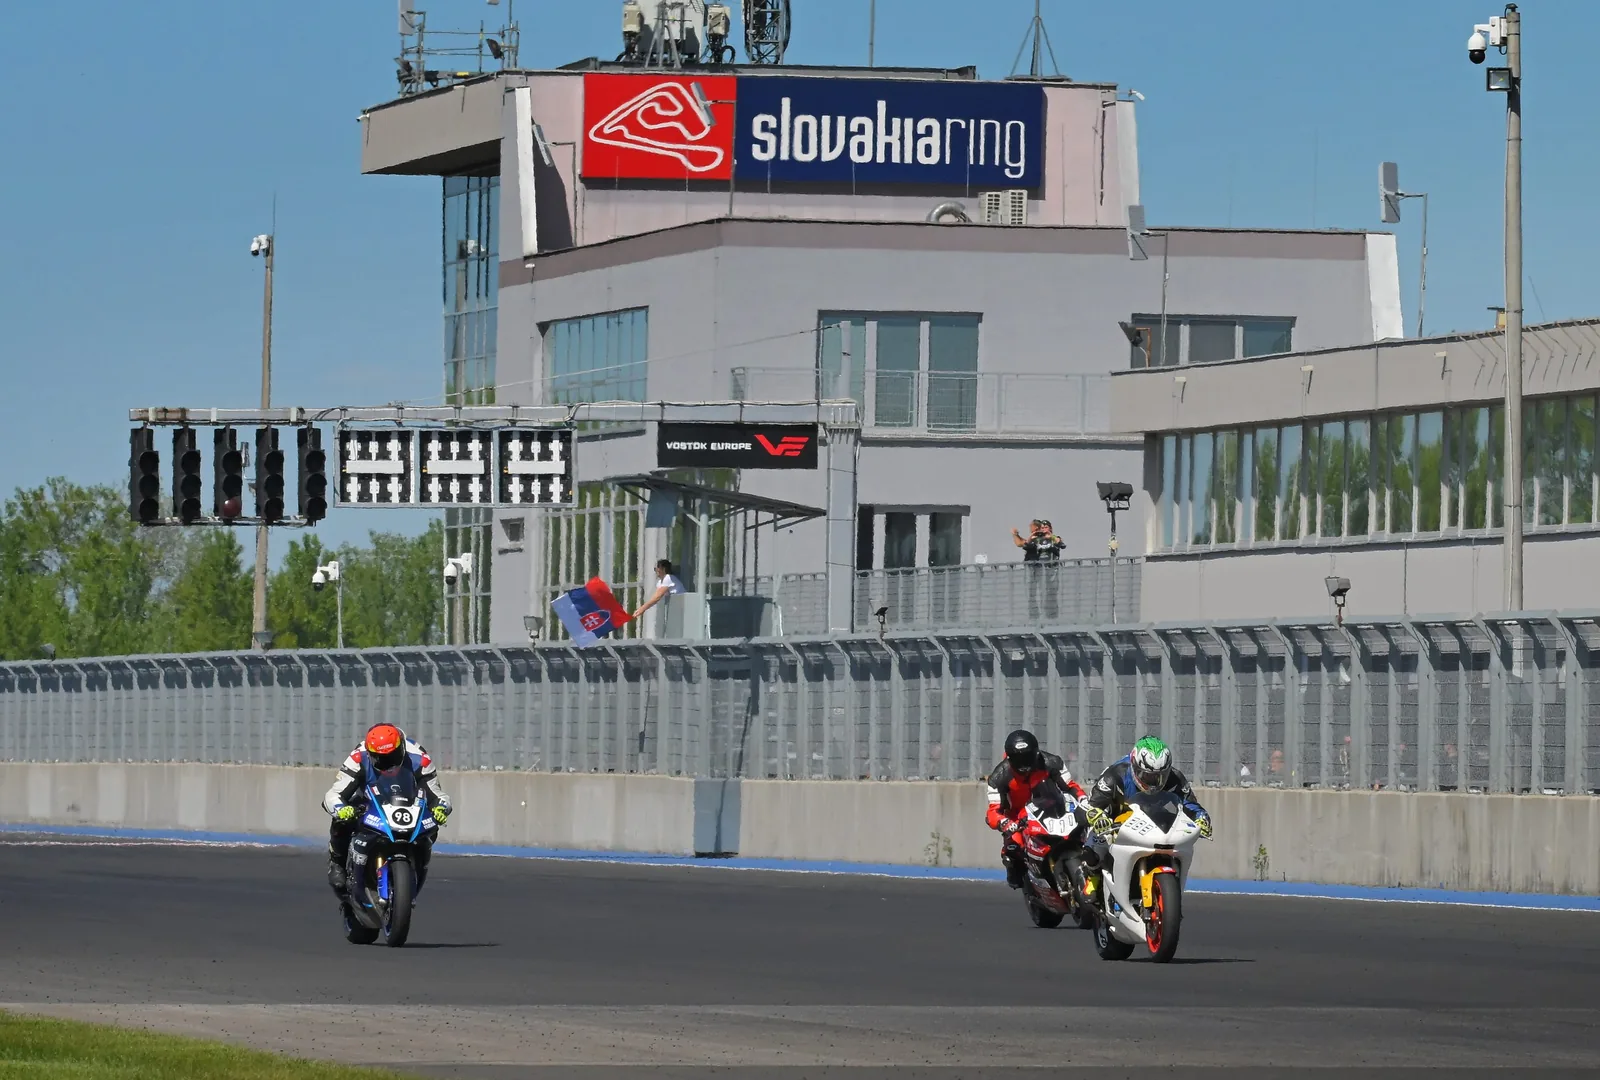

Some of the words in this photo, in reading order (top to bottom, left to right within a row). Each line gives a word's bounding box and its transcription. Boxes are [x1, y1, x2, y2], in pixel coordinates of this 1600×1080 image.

[666, 441, 707, 450] VOSTOK
[710, 442, 752, 450] EUROPE
[394, 811, 411, 823] 98
